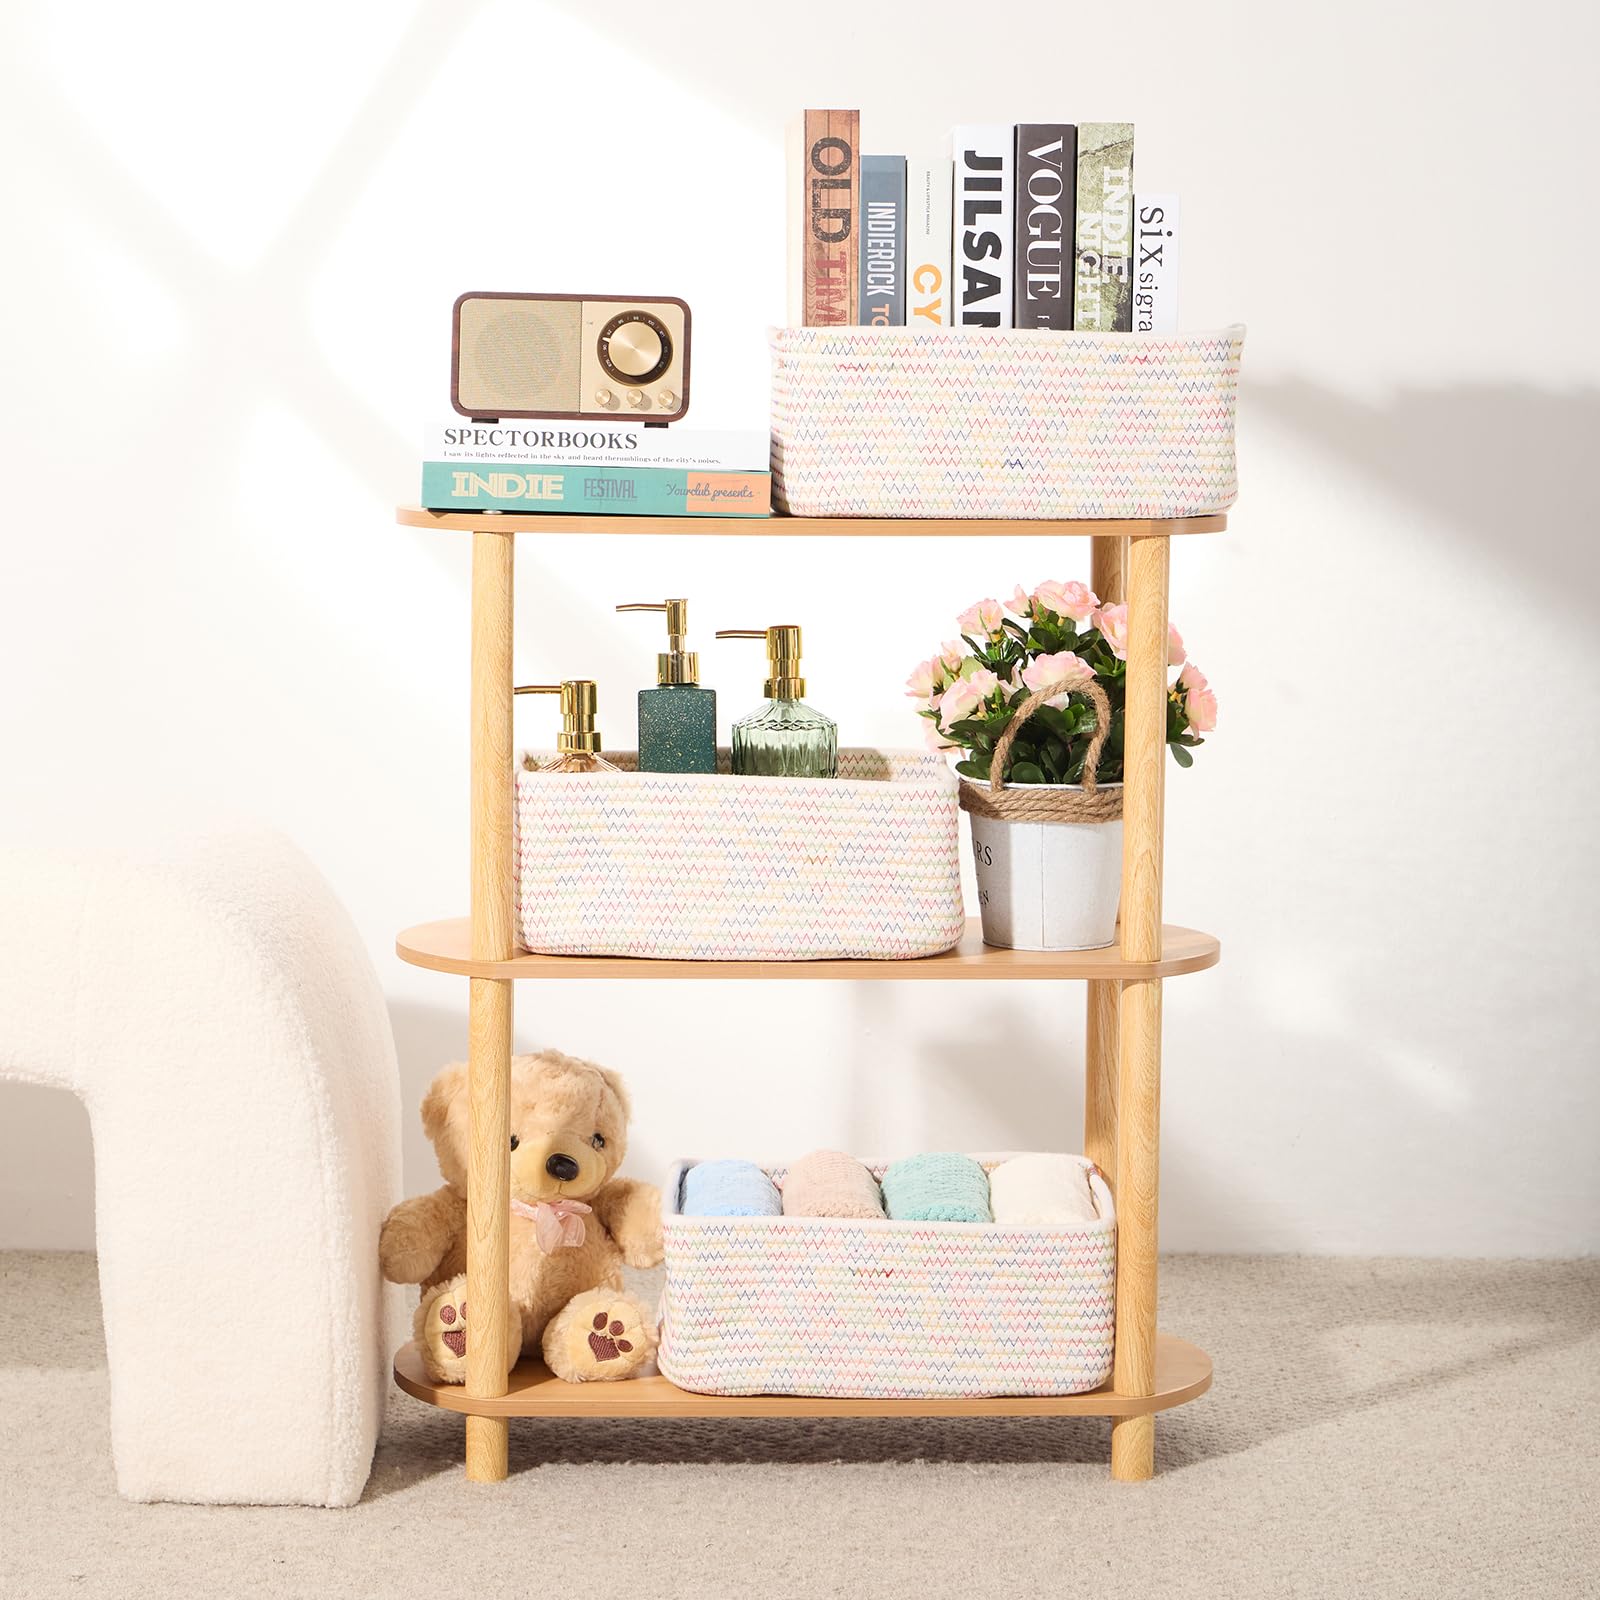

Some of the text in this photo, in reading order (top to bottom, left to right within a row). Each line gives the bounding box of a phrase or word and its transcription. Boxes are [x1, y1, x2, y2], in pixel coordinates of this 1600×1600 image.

[811, 136, 852, 327] OLD TIM
[866, 201, 896, 297] INDIEROCK
[1026, 136, 1064, 301] VOGUE
[1101, 165, 1131, 284] INDIE
[913, 264, 942, 325] CY
[1077, 210, 1104, 327] NIGHT
[443, 428, 638, 450] SPECTORBOOKS
[475, 451, 496, 459] lights
[530, 452, 538, 460] in
[553, 453, 565, 462] sky
[663, 456, 674, 464] the
[451, 471, 638, 501] INDIE FESTIVAL
[710, 485, 754, 502] presents
